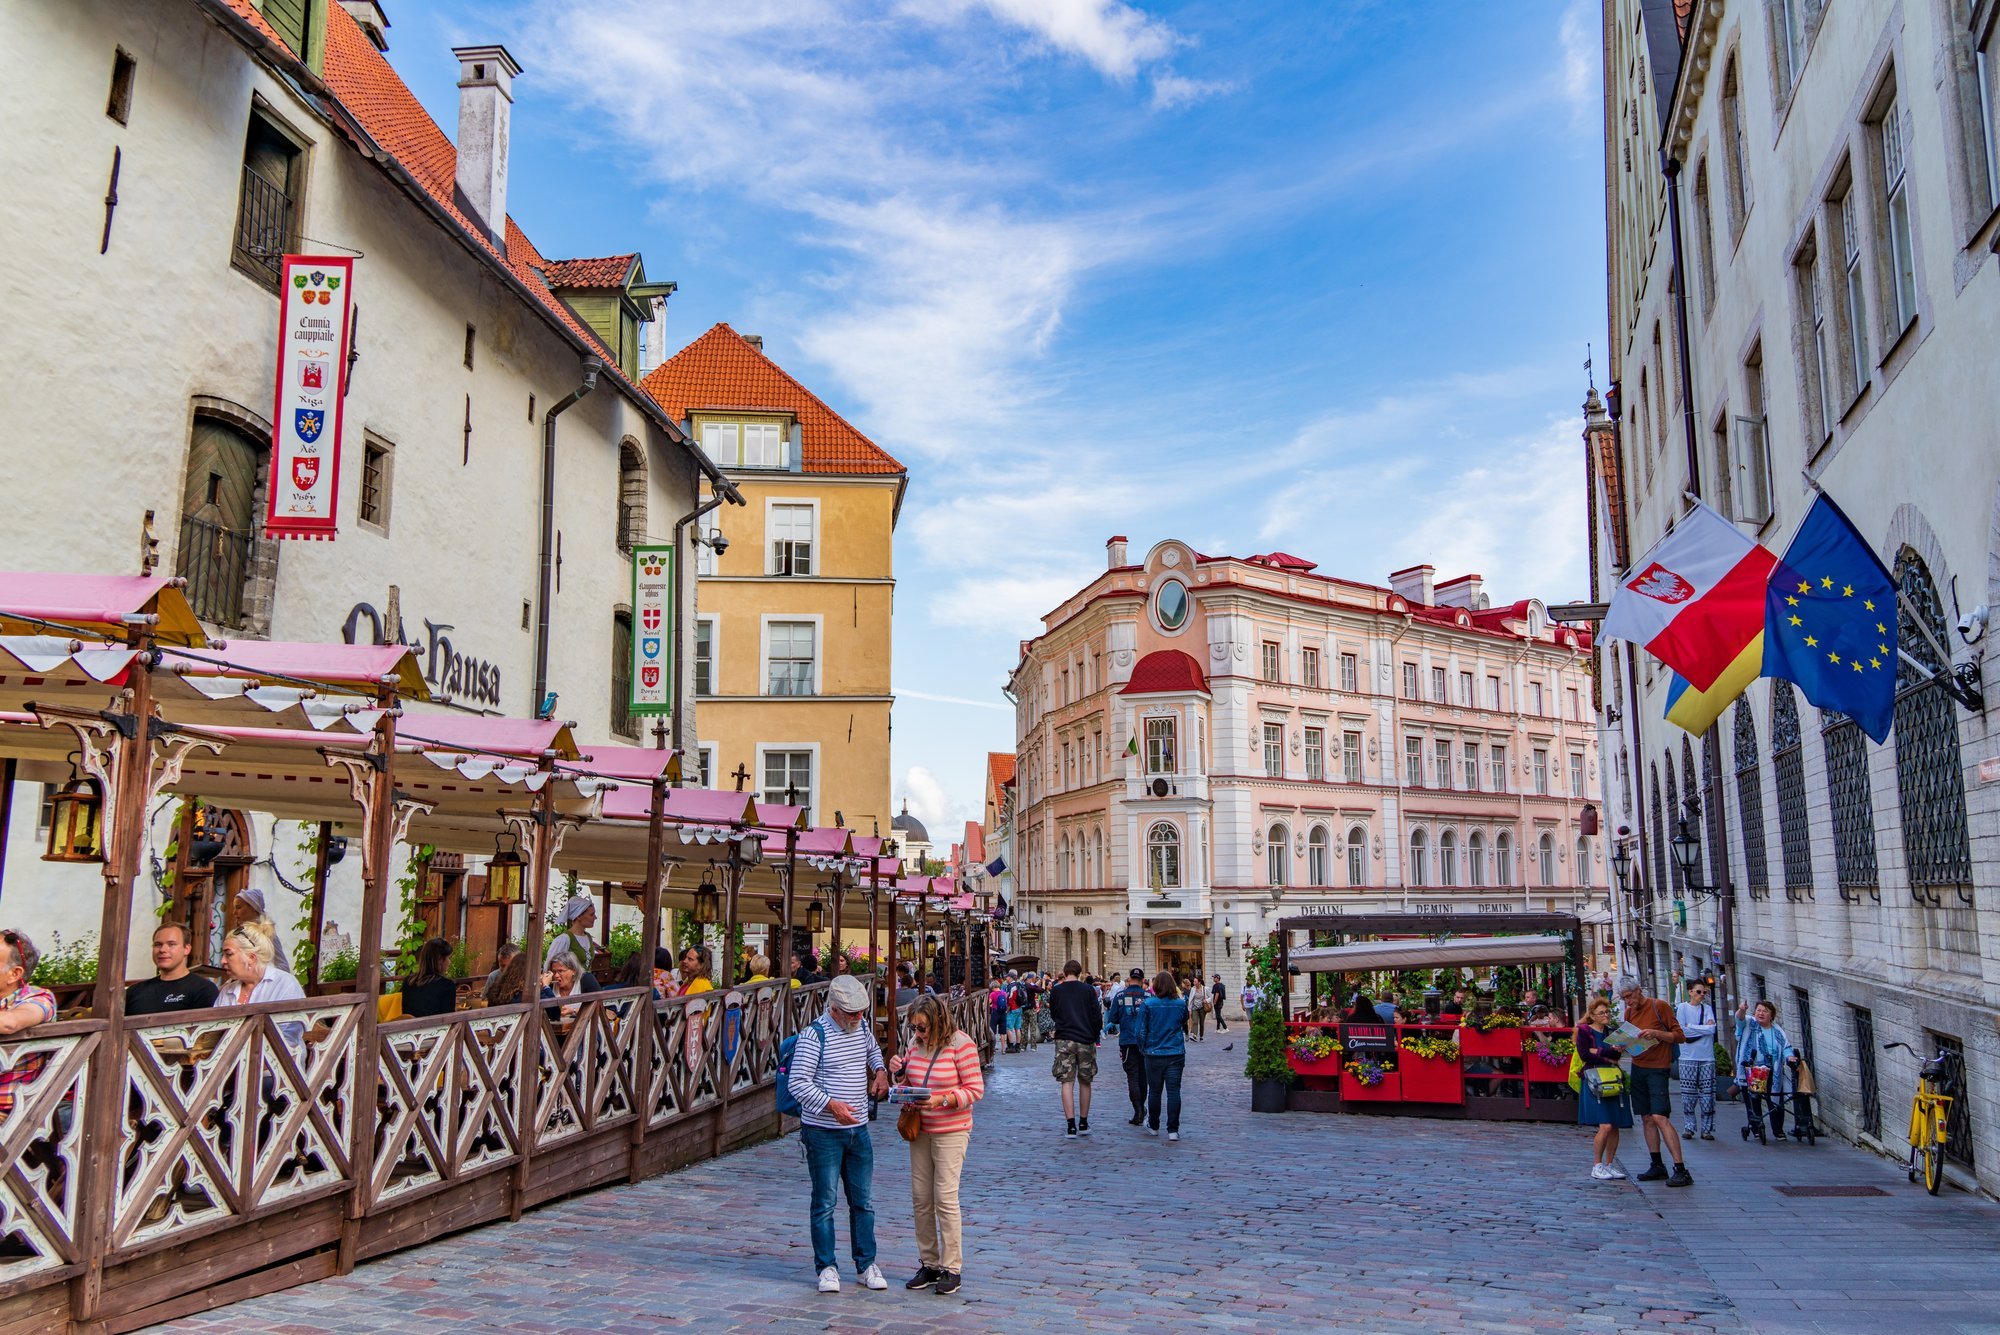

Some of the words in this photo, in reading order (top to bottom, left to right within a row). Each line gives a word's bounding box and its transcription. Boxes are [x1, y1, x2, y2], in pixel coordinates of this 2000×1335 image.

[300, 316, 330, 329] Cunnia
[293, 492, 316, 504] Visby
[1348, 1026, 1373, 1036] MAMMA
[1373, 1027, 1386, 1036] MIA
